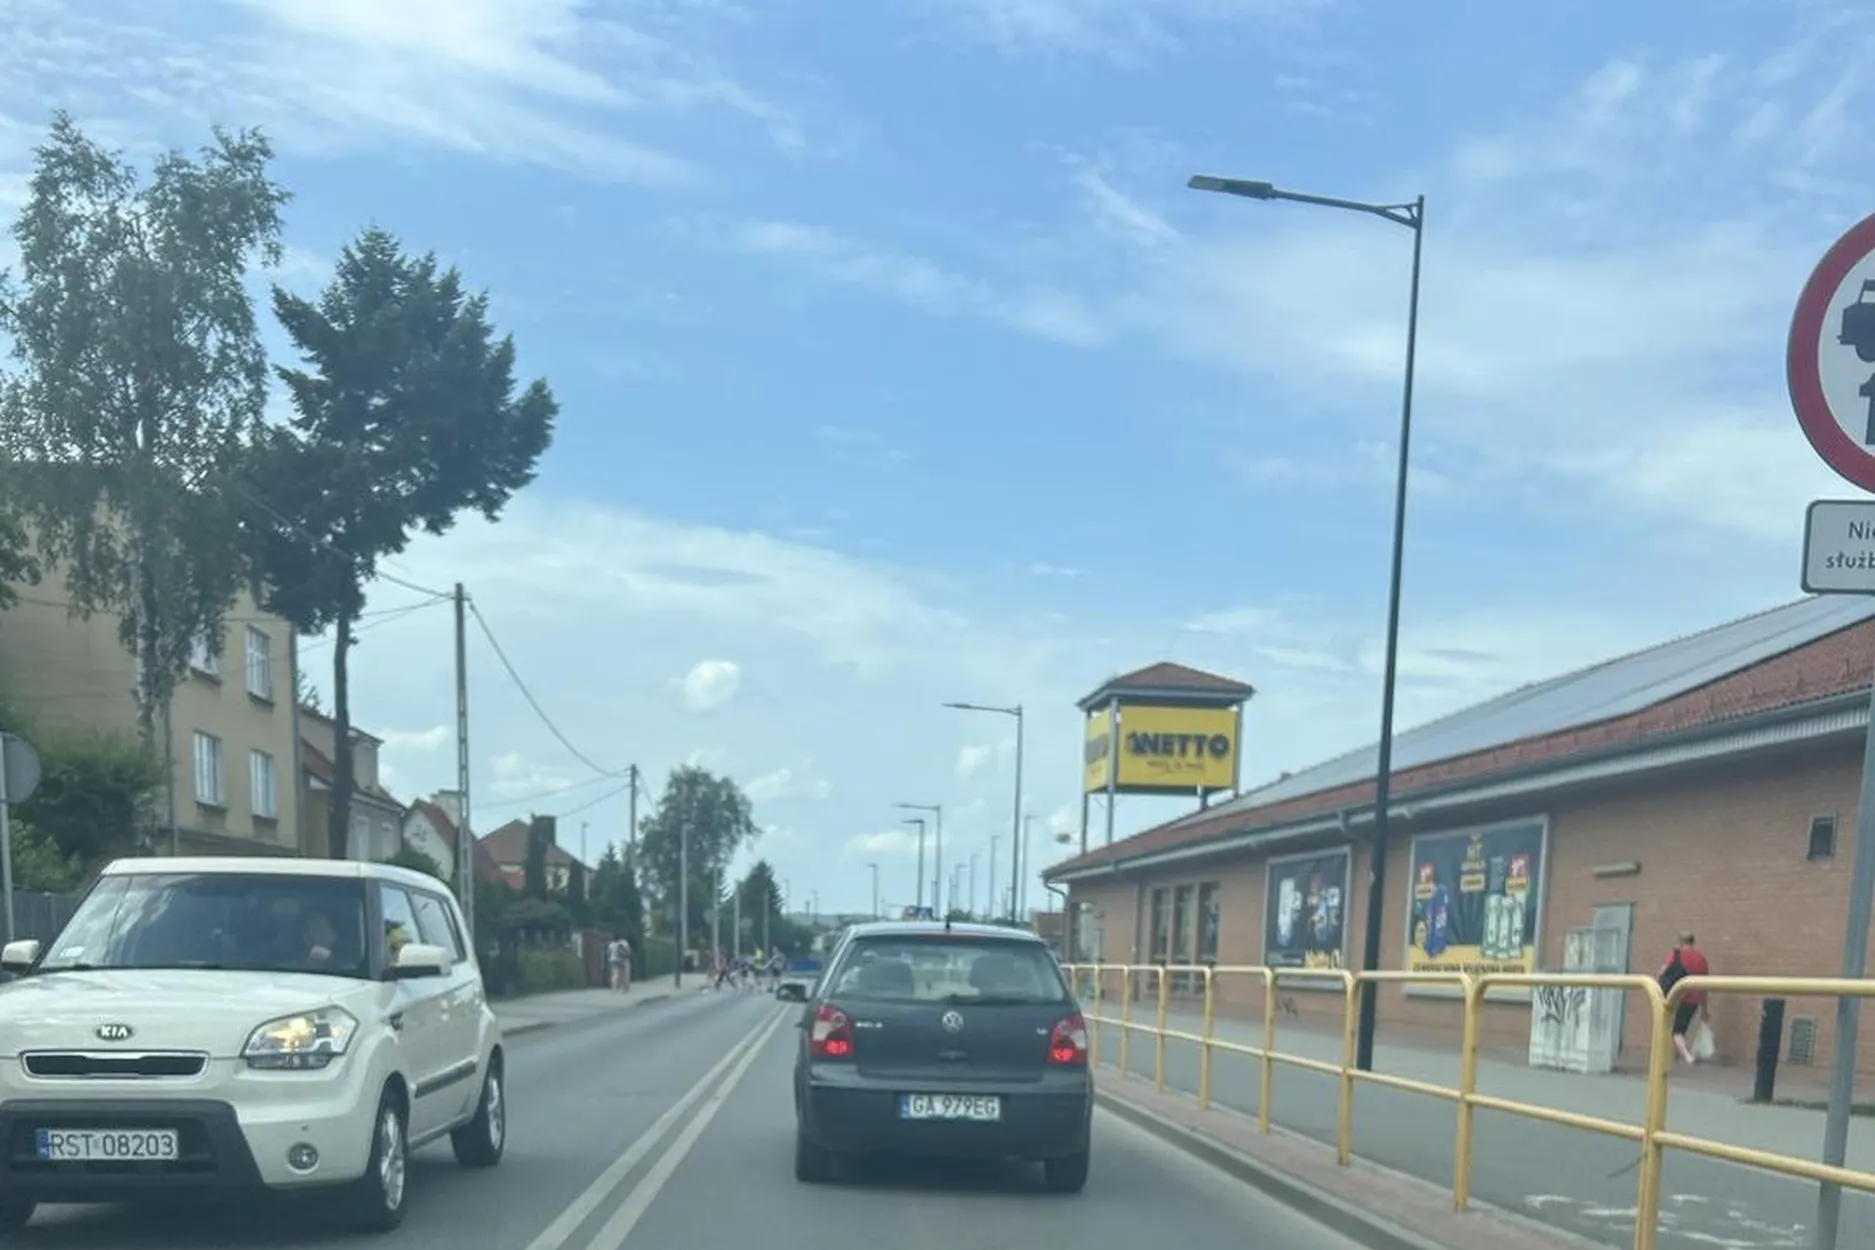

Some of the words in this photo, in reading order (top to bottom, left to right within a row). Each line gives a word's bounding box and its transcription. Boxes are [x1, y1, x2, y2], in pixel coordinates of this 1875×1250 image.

[1135, 732, 1231, 759] NETTO
[101, 1025, 129, 1038] KIA
[913, 1096, 936, 1115] GA
[51, 1133, 94, 1157] RST
[102, 1133, 174, 1157] 08203
